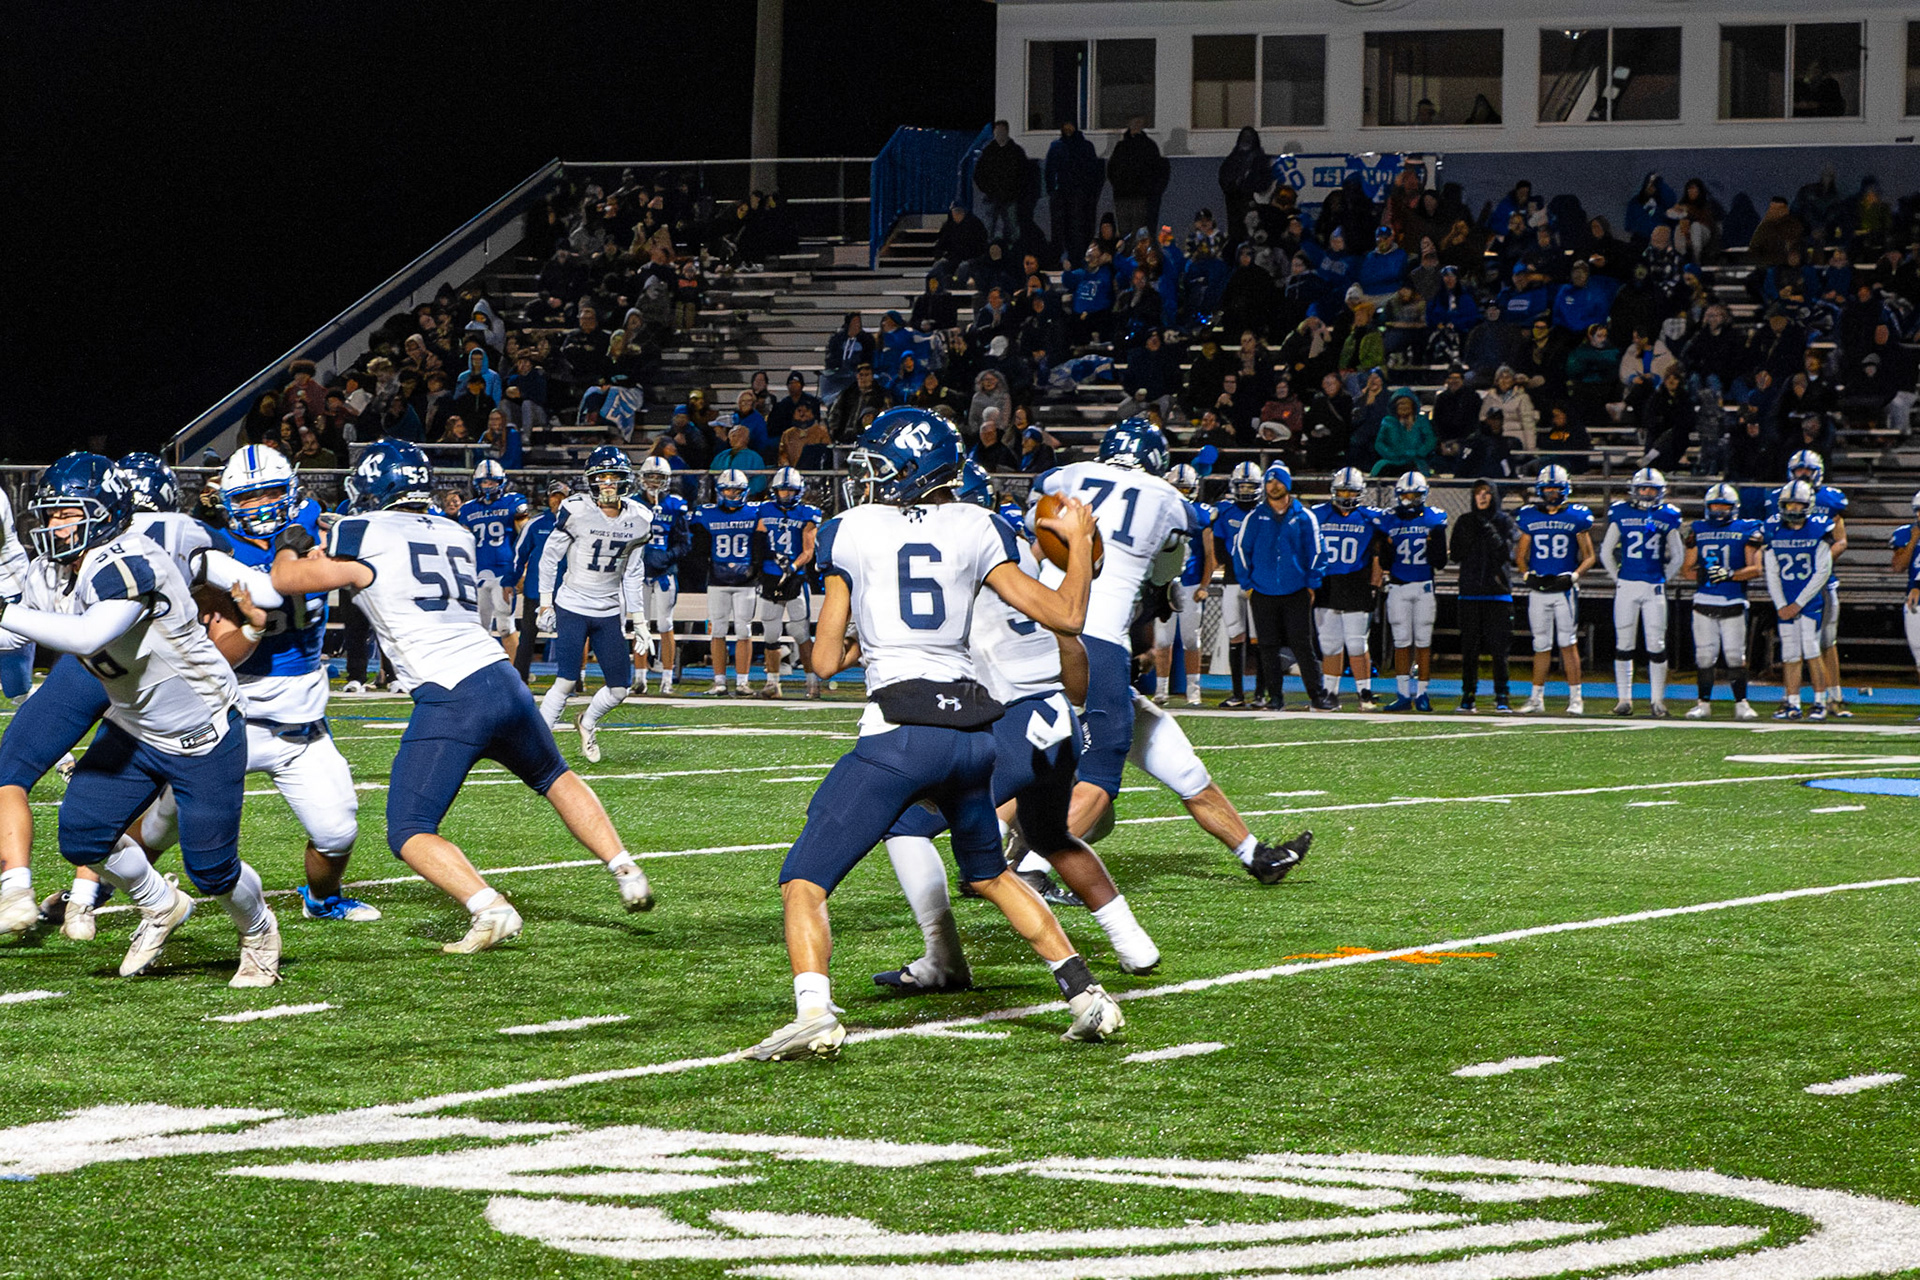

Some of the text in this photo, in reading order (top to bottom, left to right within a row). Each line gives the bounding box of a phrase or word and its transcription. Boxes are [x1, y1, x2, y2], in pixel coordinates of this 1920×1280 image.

[1080, 477, 1141, 549] 71
[473, 521, 505, 548] 79
[716, 534, 749, 558] 80
[767, 529, 794, 555] 14
[1534, 534, 1569, 559] 58
[1627, 531, 1662, 560] 24
[587, 538, 628, 573] 17
[1323, 536, 1358, 564] 50
[1396, 538, 1428, 565] 42
[407, 541, 478, 612] 56
[1778, 552, 1812, 580] 23
[898, 542, 946, 630] 6
